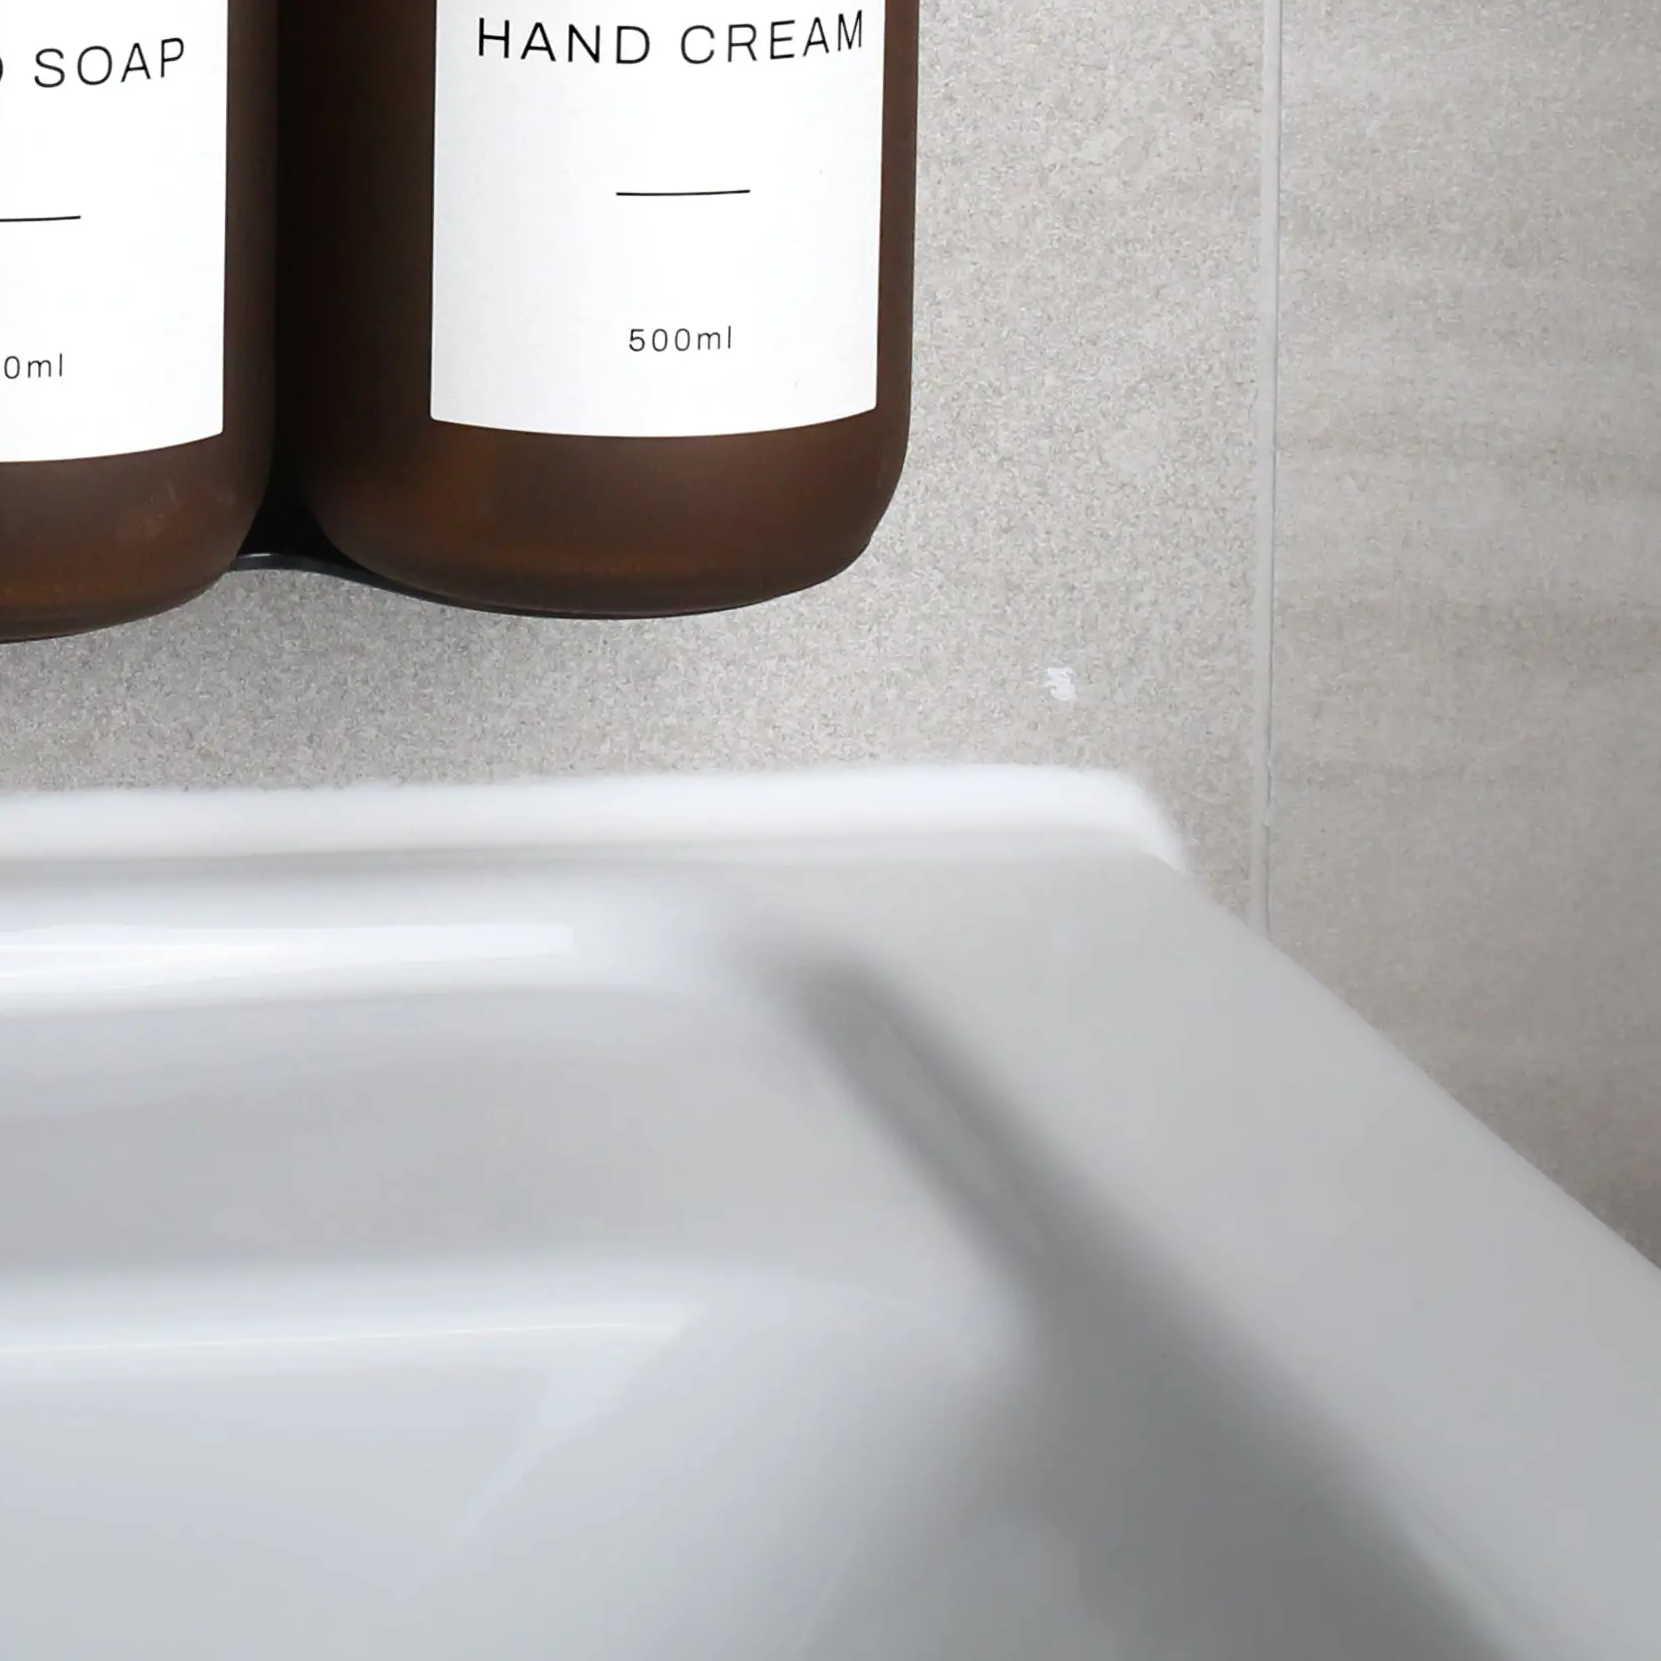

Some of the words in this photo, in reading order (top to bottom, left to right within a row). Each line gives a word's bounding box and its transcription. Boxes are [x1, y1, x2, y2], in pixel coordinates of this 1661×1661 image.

[32, 36, 186, 90] SOAP
[477, 16, 652, 66] HAND
[679, 8, 864, 66] CREAM
[627, 324, 733, 353] 500ml
